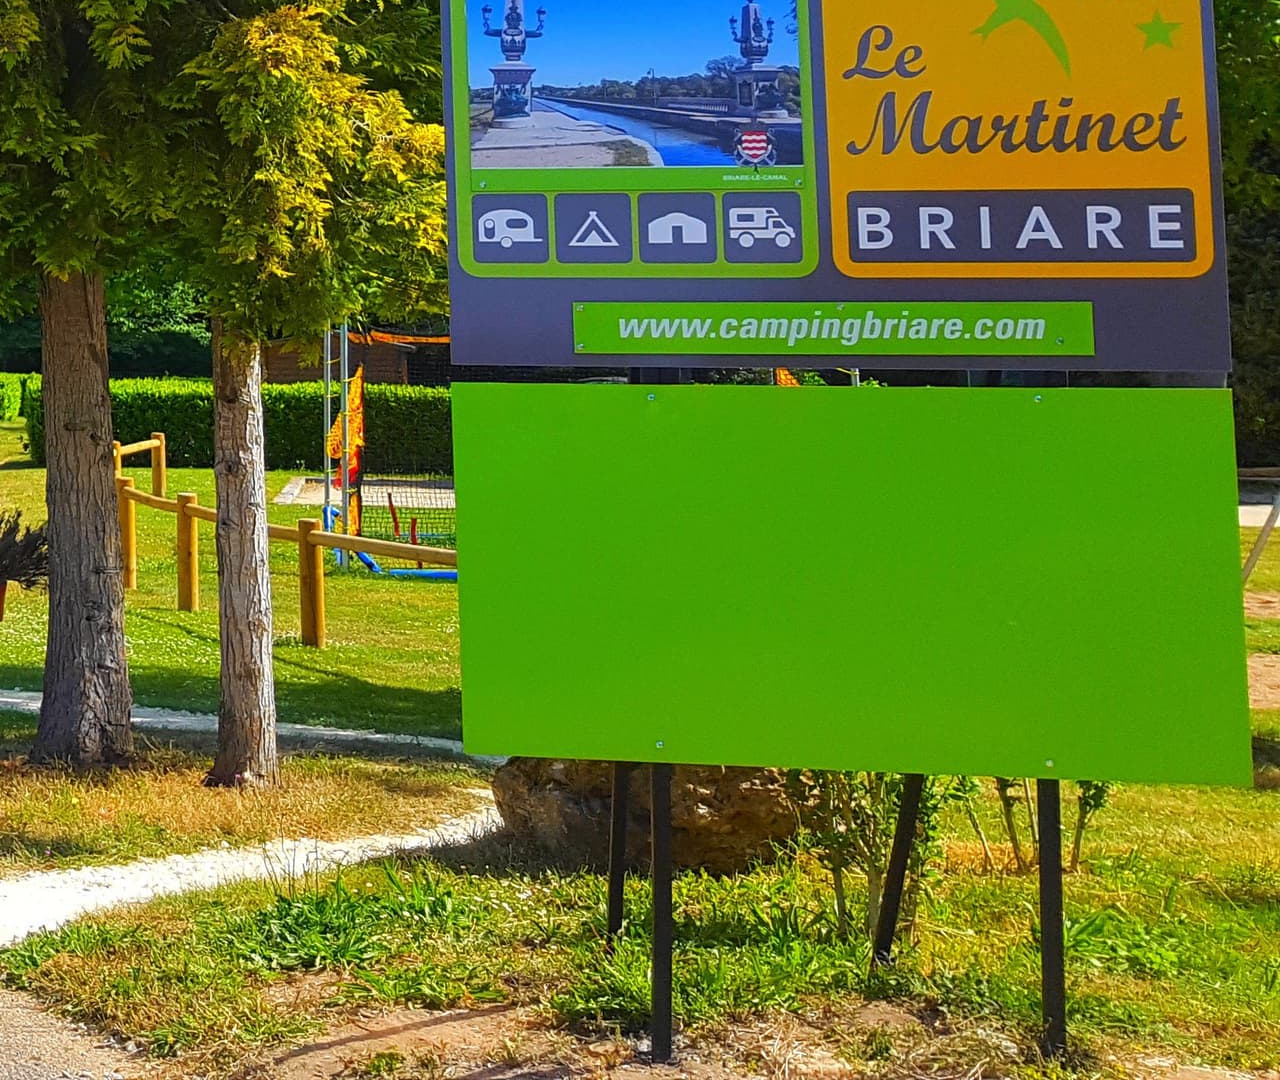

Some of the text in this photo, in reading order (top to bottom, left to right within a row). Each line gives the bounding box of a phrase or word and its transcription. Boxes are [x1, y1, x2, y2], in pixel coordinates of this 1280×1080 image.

[842, 24, 926, 81] Le
[846, 90, 1188, 158] Martinet
[857, 205, 1185, 250] BRIARE
[618, 312, 1046, 346] www.campingbriare.com
